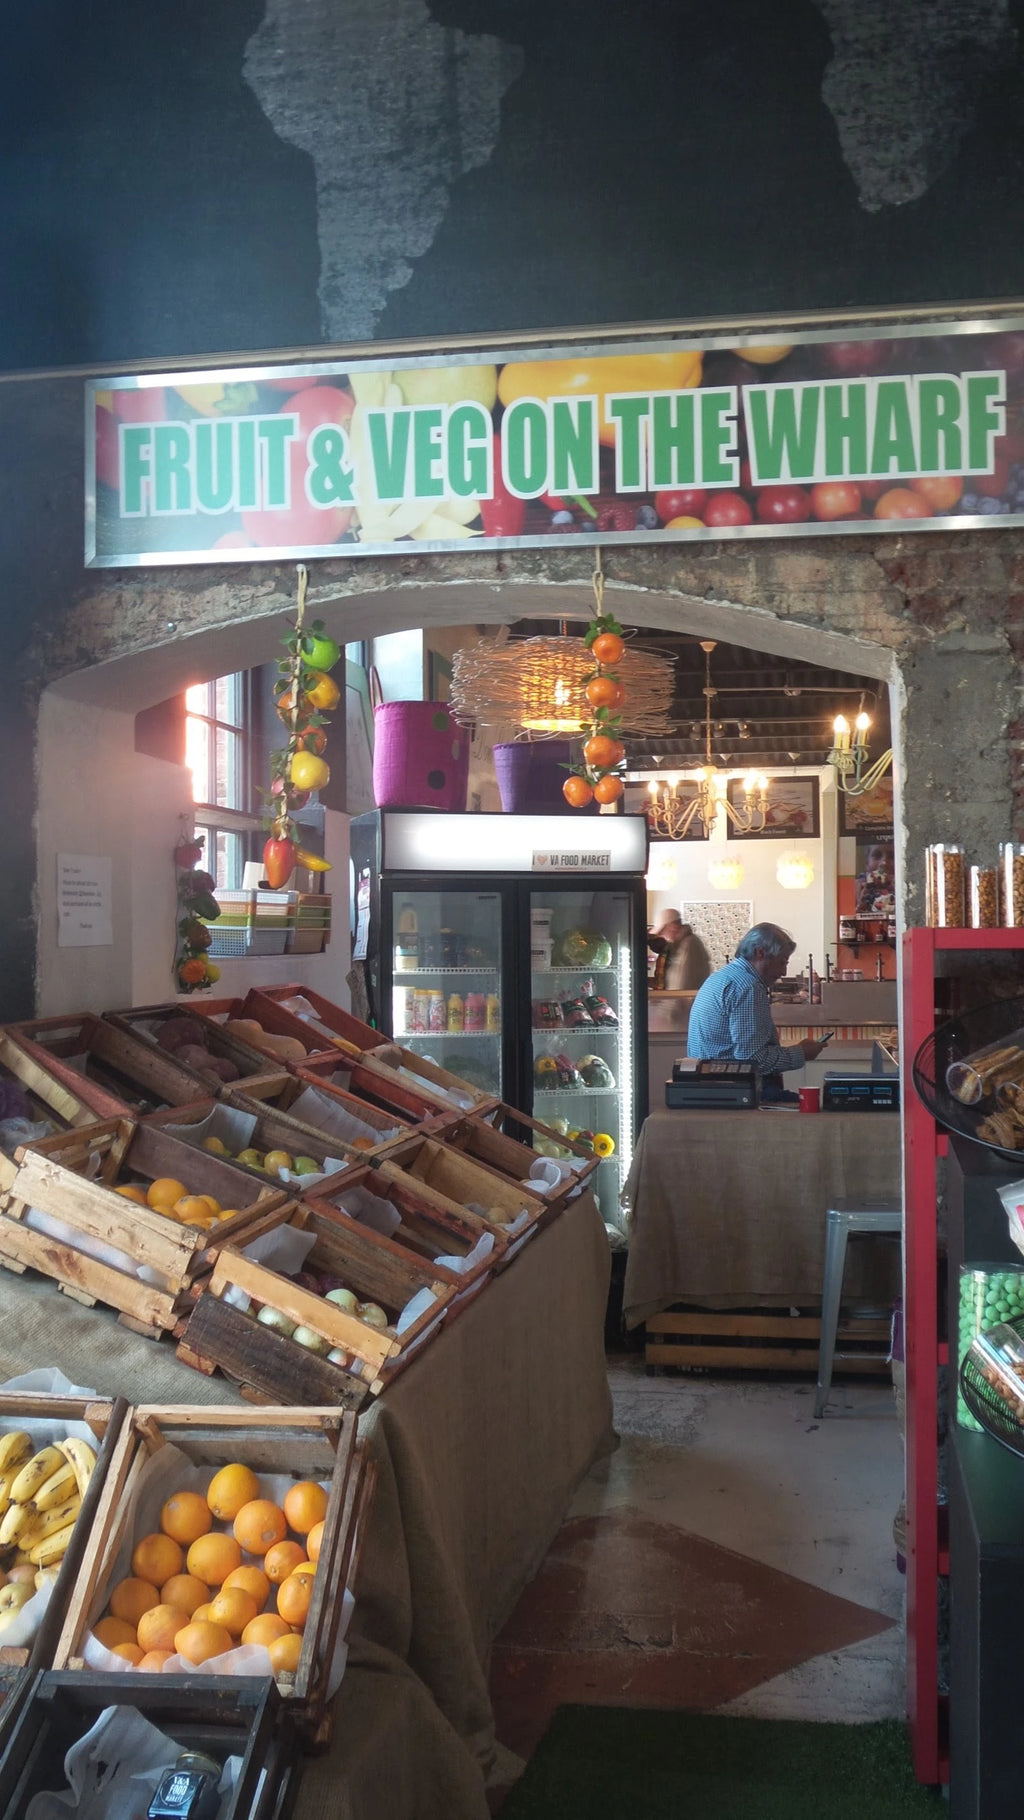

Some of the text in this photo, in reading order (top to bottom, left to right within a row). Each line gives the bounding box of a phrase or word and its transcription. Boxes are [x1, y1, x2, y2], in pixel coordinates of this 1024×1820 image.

[119, 370, 1007, 518] FRUIT & VEG ON THE WHARF
[560, 854, 579, 866] FOOD
[581, 854, 610, 866] MARKET
[168, 1784, 188, 1795] FOOD
